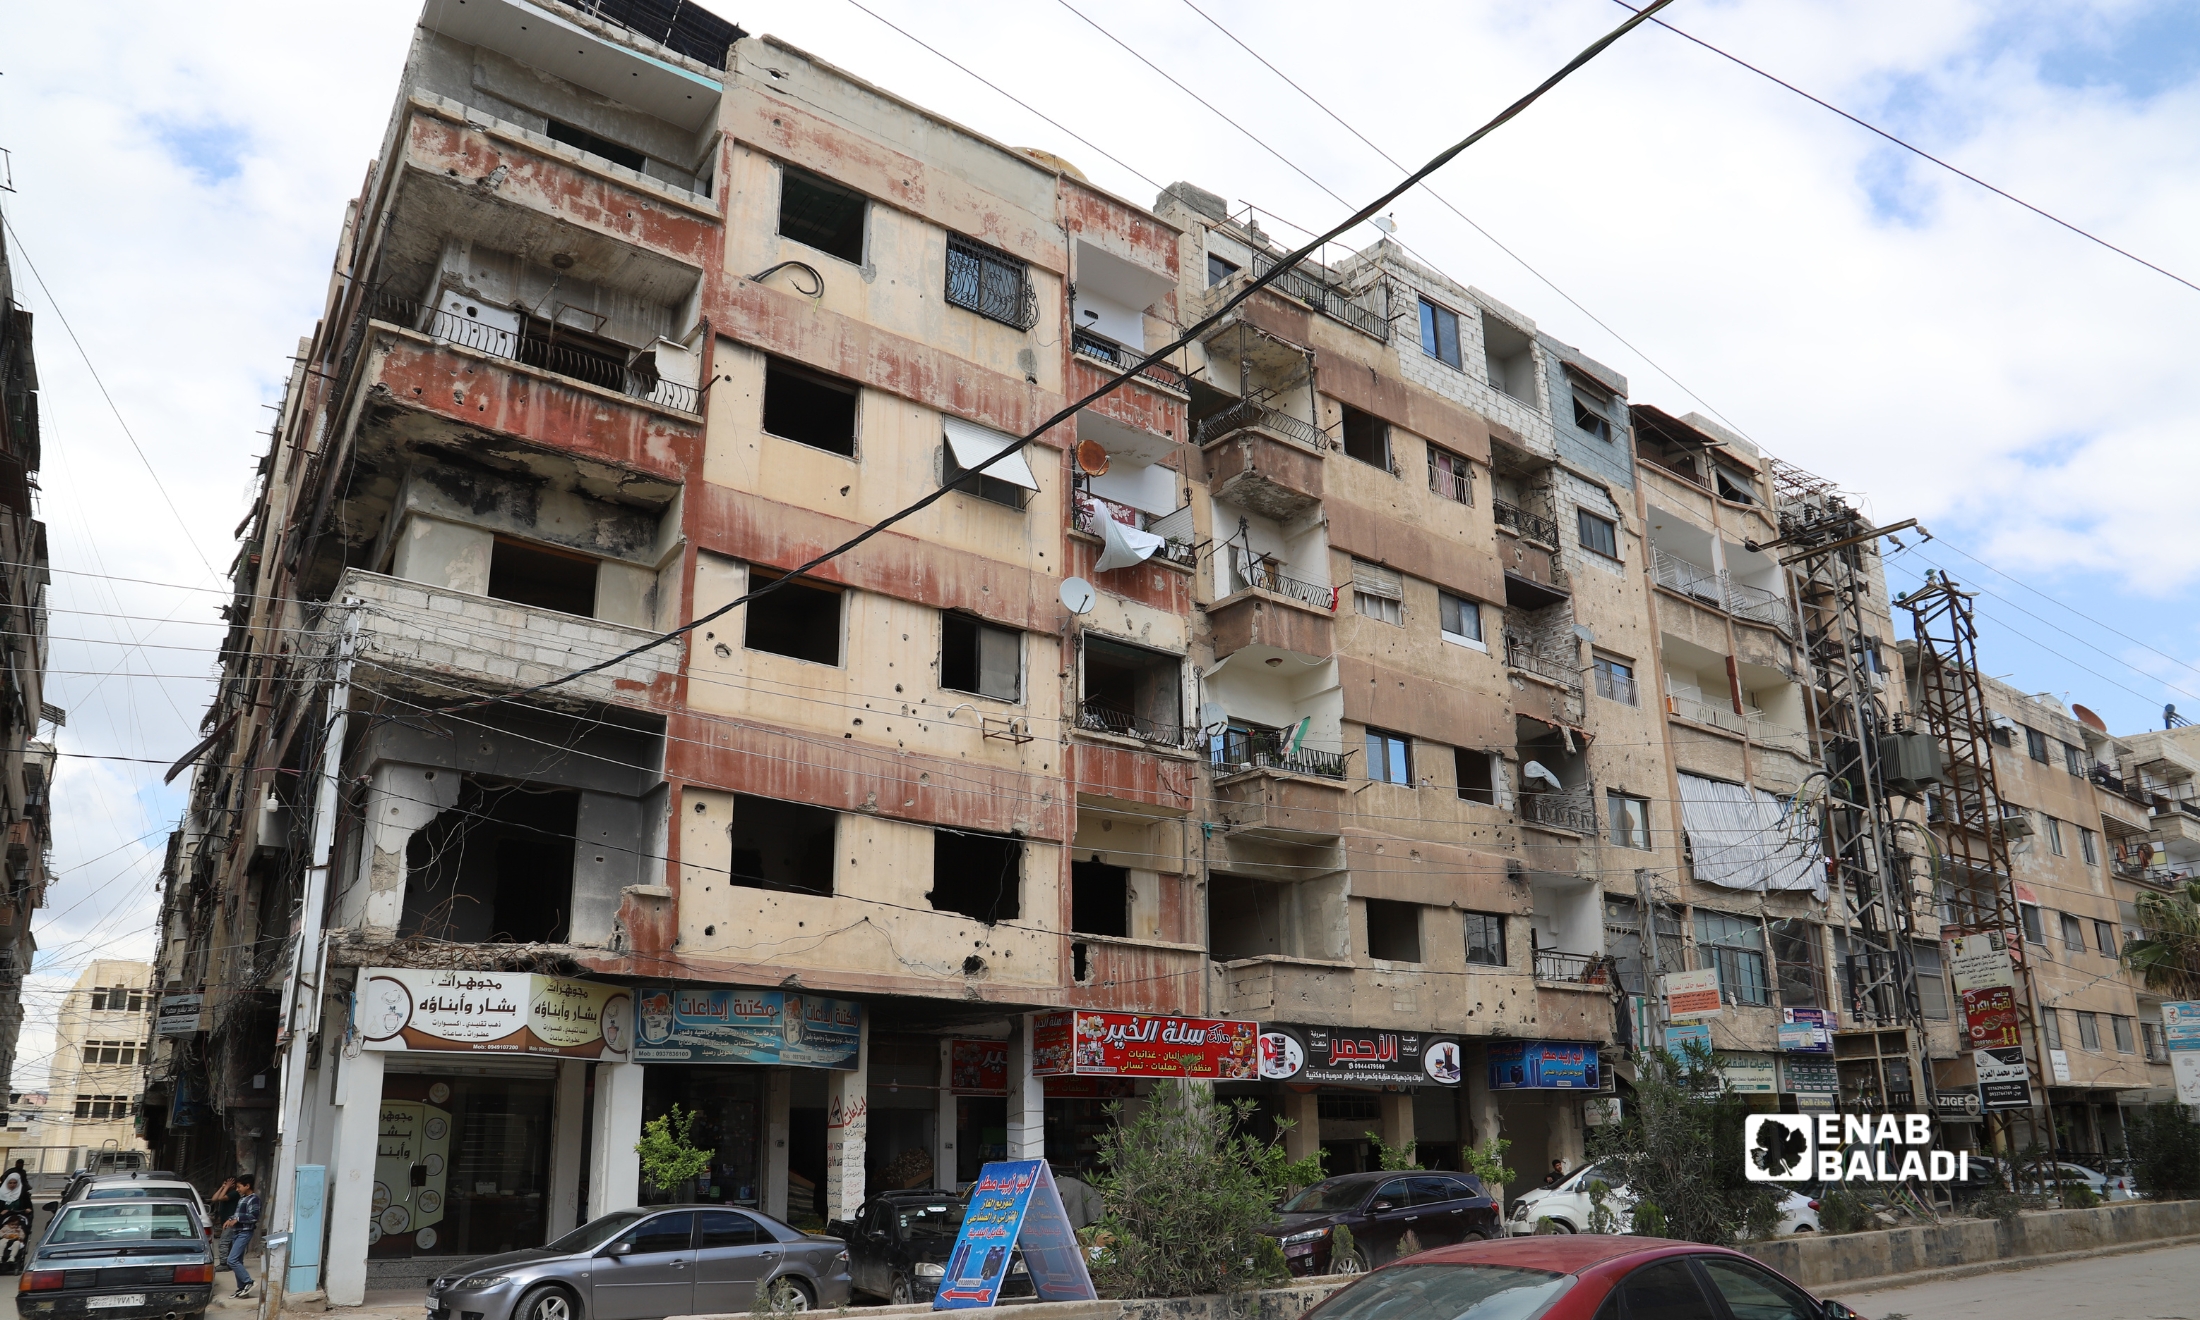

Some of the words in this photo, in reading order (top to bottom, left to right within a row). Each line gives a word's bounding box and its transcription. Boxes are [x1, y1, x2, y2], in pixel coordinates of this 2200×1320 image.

[438, 975, 502, 990] مجوهرات
[547, 981, 588, 999] مجوهرات
[419, 993, 473, 1014] وأبناؤه
[477, 998, 516, 1016] بشار
[535, 999, 570, 1021] وأبناؤه
[678, 998, 729, 1021] إبداعات
[734, 999, 776, 1021] مكتبة
[1969, 1000, 1990, 1015] الكرم
[1991, 997, 2011, 1011] لقمة
[573, 1005, 597, 1024] بشار
[805, 1004, 834, 1028] إبداعات
[835, 1007, 858, 1029] مكتبة
[1103, 1017, 1160, 1049] الخير
[1162, 1020, 1206, 1046] سلة
[1207, 1023, 1230, 1044] ماركت
[1128, 1050, 1157, 1059] غذائيات
[1329, 1033, 1398, 1066] الأحمر
[1558, 1048, 1571, 1065] زيد
[1120, 1061, 1144, 1073] تسالي
[1151, 1063, 1177, 1072] معلبات
[1728, 1055, 1749, 1068] الشفا
[1996, 1069, 2010, 1077] محمد
[380, 1111, 413, 1123] مجوهرا
[378, 1125, 412, 1140] بش
[378, 1141, 410, 1159] وأبنا
[975, 1175, 998, 1197] مطر
[998, 1174, 1016, 1195] زيد
[1016, 1165, 1036, 1195] أبو
